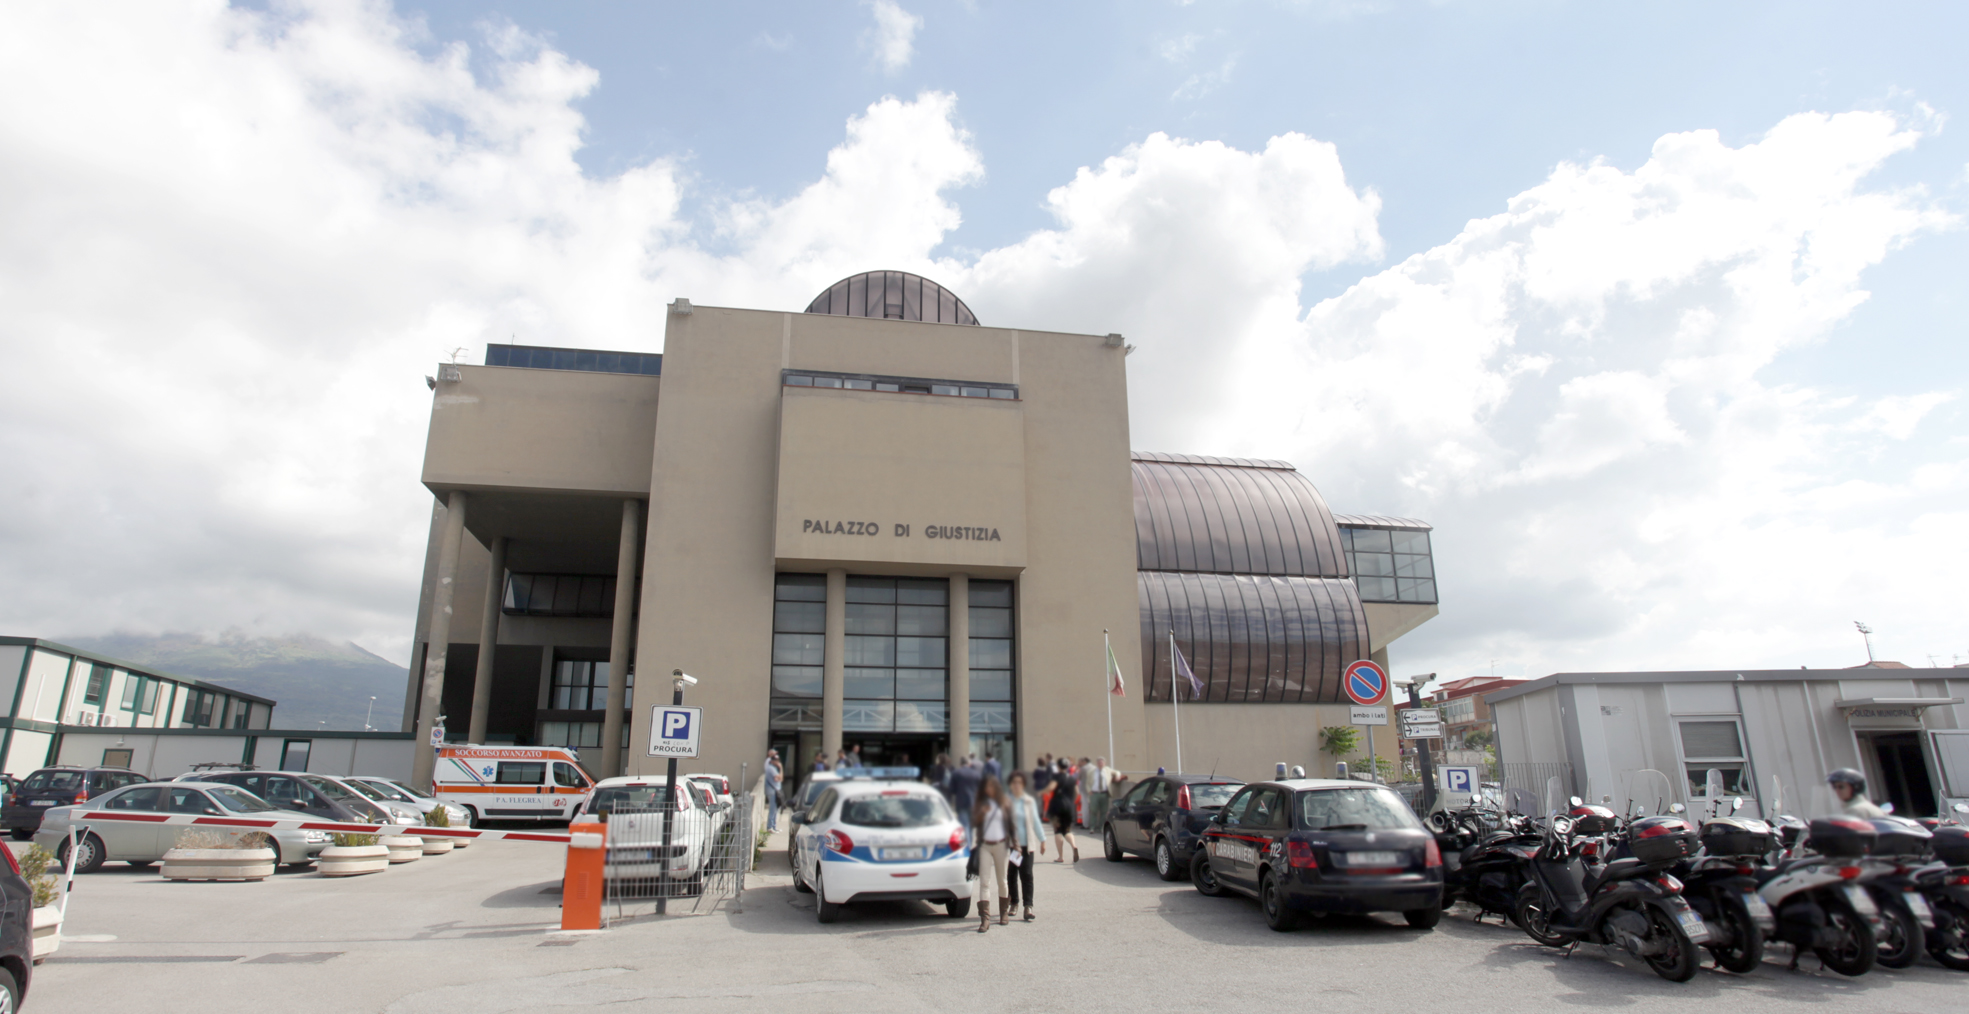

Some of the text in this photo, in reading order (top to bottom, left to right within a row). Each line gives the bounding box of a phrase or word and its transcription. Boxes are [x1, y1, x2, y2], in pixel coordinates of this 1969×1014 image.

[803, 519, 1001, 542] PALAZZO DI GIUSTIZIA
[1877, 709, 1916, 717] MUNICIPALE
[665, 713, 687, 737] P
[455, 749, 543, 758] SOCCORSO AVANZATO
[653, 745, 693, 753] PROCURA
[1449, 771, 1467, 791] P
[1215, 842, 1255, 863] CARABINIERI
[1269, 842, 1282, 857] 112
